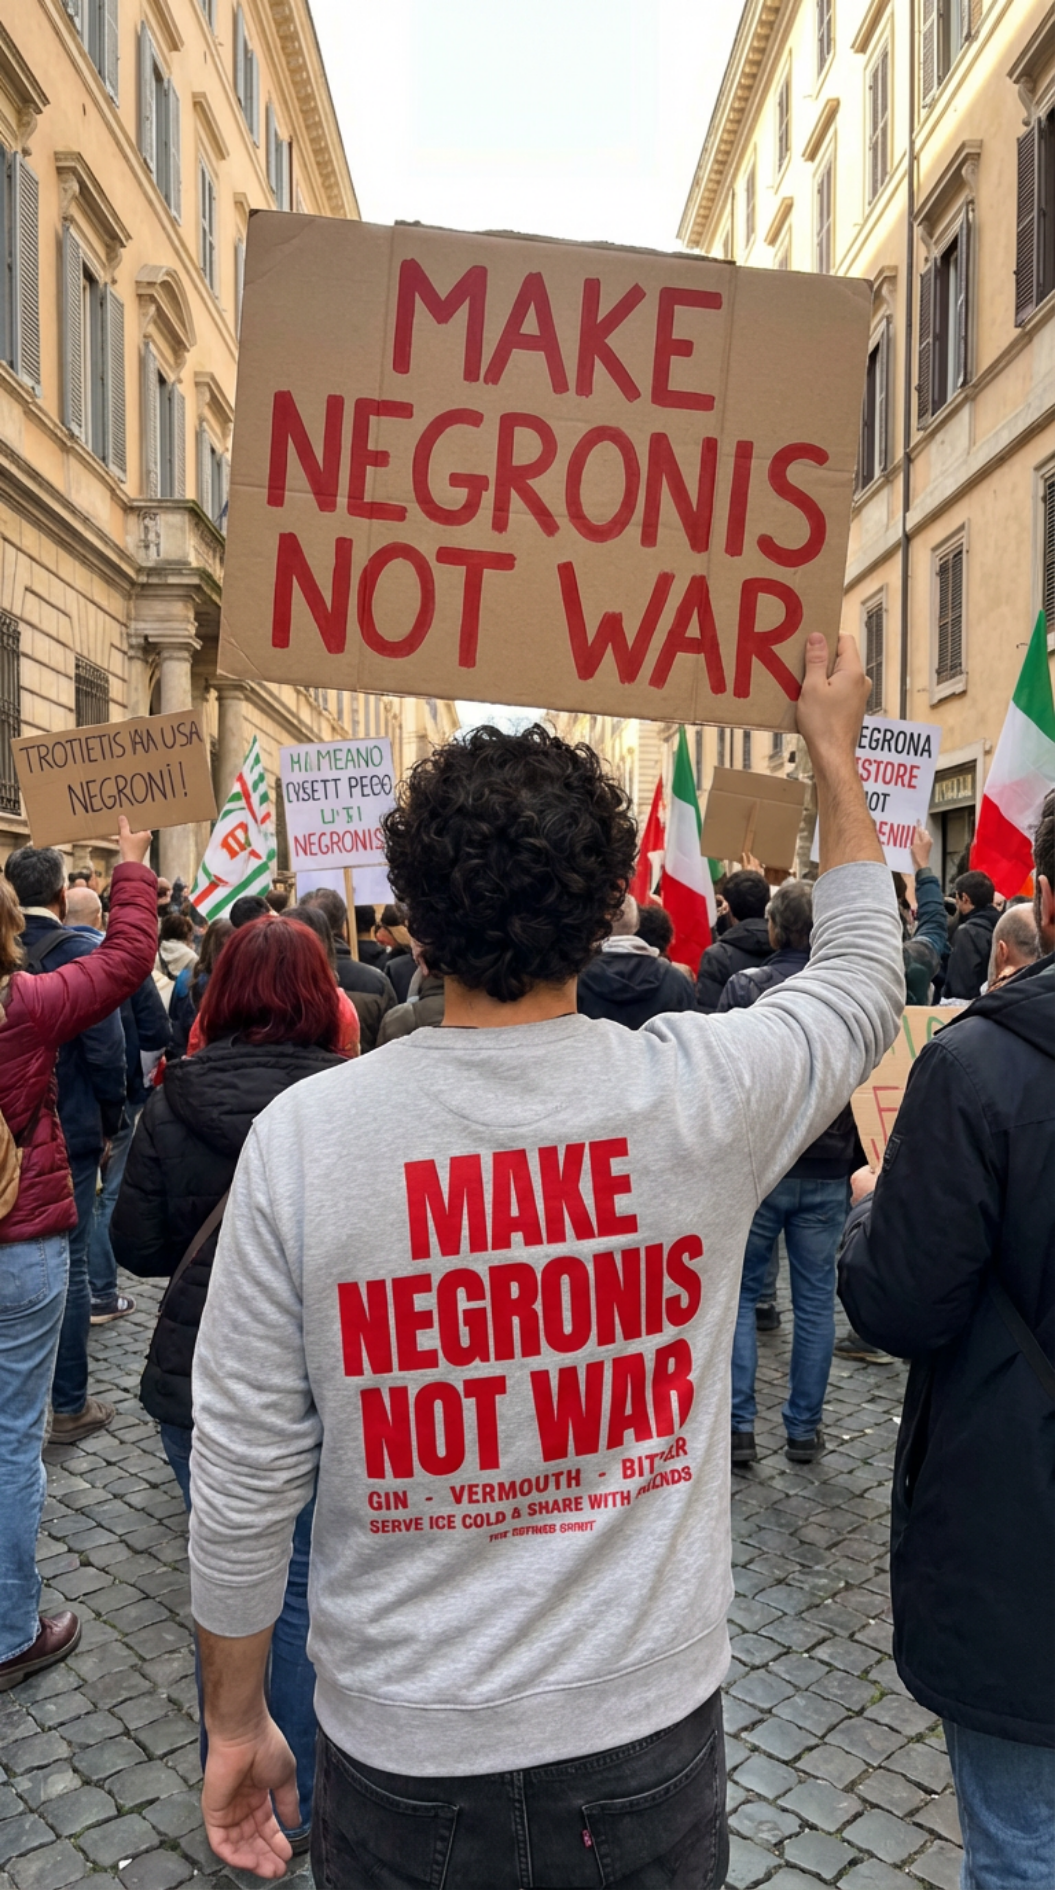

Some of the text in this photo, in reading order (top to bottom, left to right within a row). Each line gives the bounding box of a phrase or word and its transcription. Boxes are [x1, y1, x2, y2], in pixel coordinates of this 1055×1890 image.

[392, 258, 723, 411] MAKE
[266, 389, 830, 568] NEGRONIS
[271, 532, 804, 702] NOT WAR
[161, 720, 203, 750] USA
[857, 725, 933, 759] EGRONA
[293, 827, 387, 858] NEGRONIS
[403, 1136, 639, 1261] MAKE
[337, 1233, 704, 1377] NEGRONIS
[360, 1337, 695, 1480] NOT WAR
[367, 1489, 409, 1511] GIN
[449, 1468, 582, 1505] VERMOUTH
[369, 1516, 424, 1534] SERVE
[429, 1514, 456, 1531] ICE
[462, 1510, 506, 1529] COLD
[527, 1495, 584, 1517] SHARE
[588, 1489, 631, 1510] WITH
